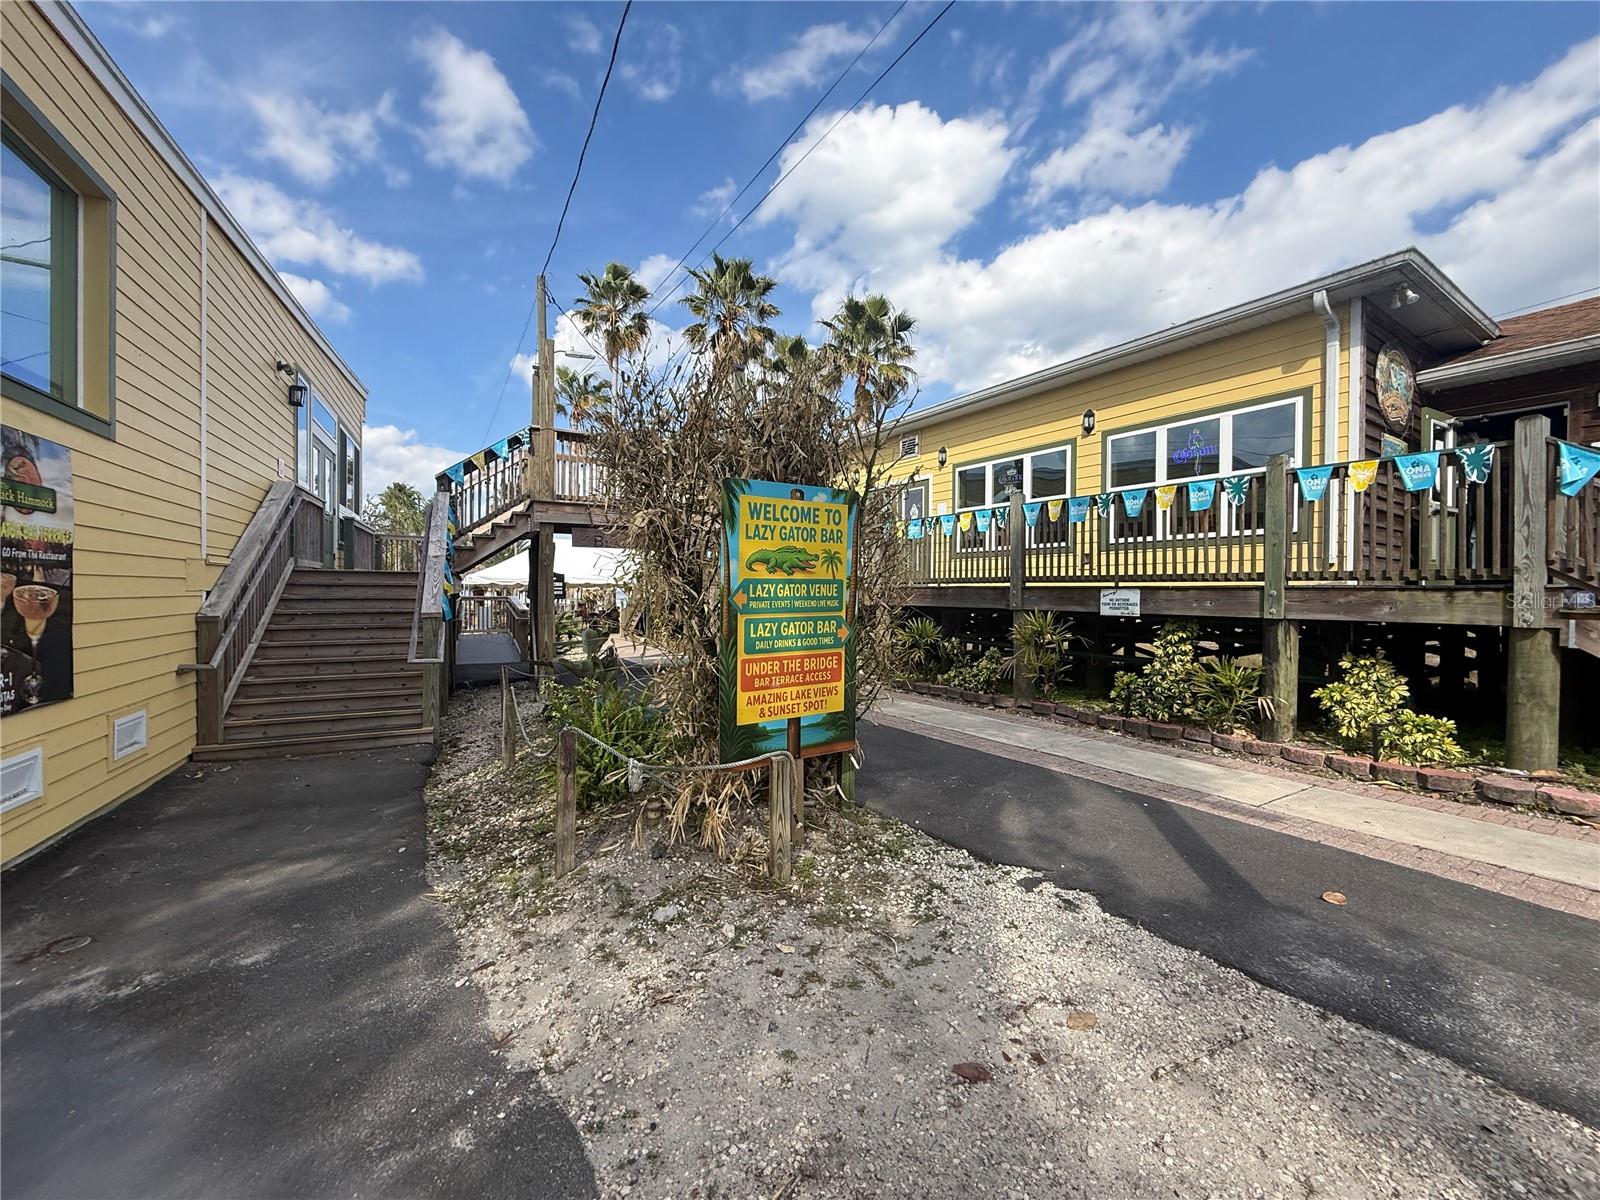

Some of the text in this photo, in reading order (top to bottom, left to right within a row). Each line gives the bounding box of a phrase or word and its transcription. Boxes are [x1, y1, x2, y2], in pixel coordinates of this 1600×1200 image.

[1404, 464, 1431, 475] ONA
[16, 490, 54, 509] Hammock
[748, 502, 842, 526] WELCOME TO
[745, 523, 843, 544] LAZY GATOR BAR
[2, 547, 67, 561] GO From The Restaurant
[749, 583, 838, 597] LAZY GATOR VENUE
[749, 600, 770, 609] PRIVATE
[772, 600, 791, 608] EVENTS
[794, 599, 817, 608] WEEKEND
[817, 599, 827, 607] LIVE
[827, 599, 839, 607] MUSIC
[750, 620, 837, 638] LAZY GATOR BAR
[755, 636, 834, 650] DAILY DRINKS & GOOD TIMES
[745, 655, 838, 676] UNDER THE BRIDGE
[754, 671, 831, 688] BAR TERRACE ACCESS
[746, 685, 839, 707] AMAZING LAKE VIEWS
[759, 699, 827, 718] & SUNSET SPOT!
